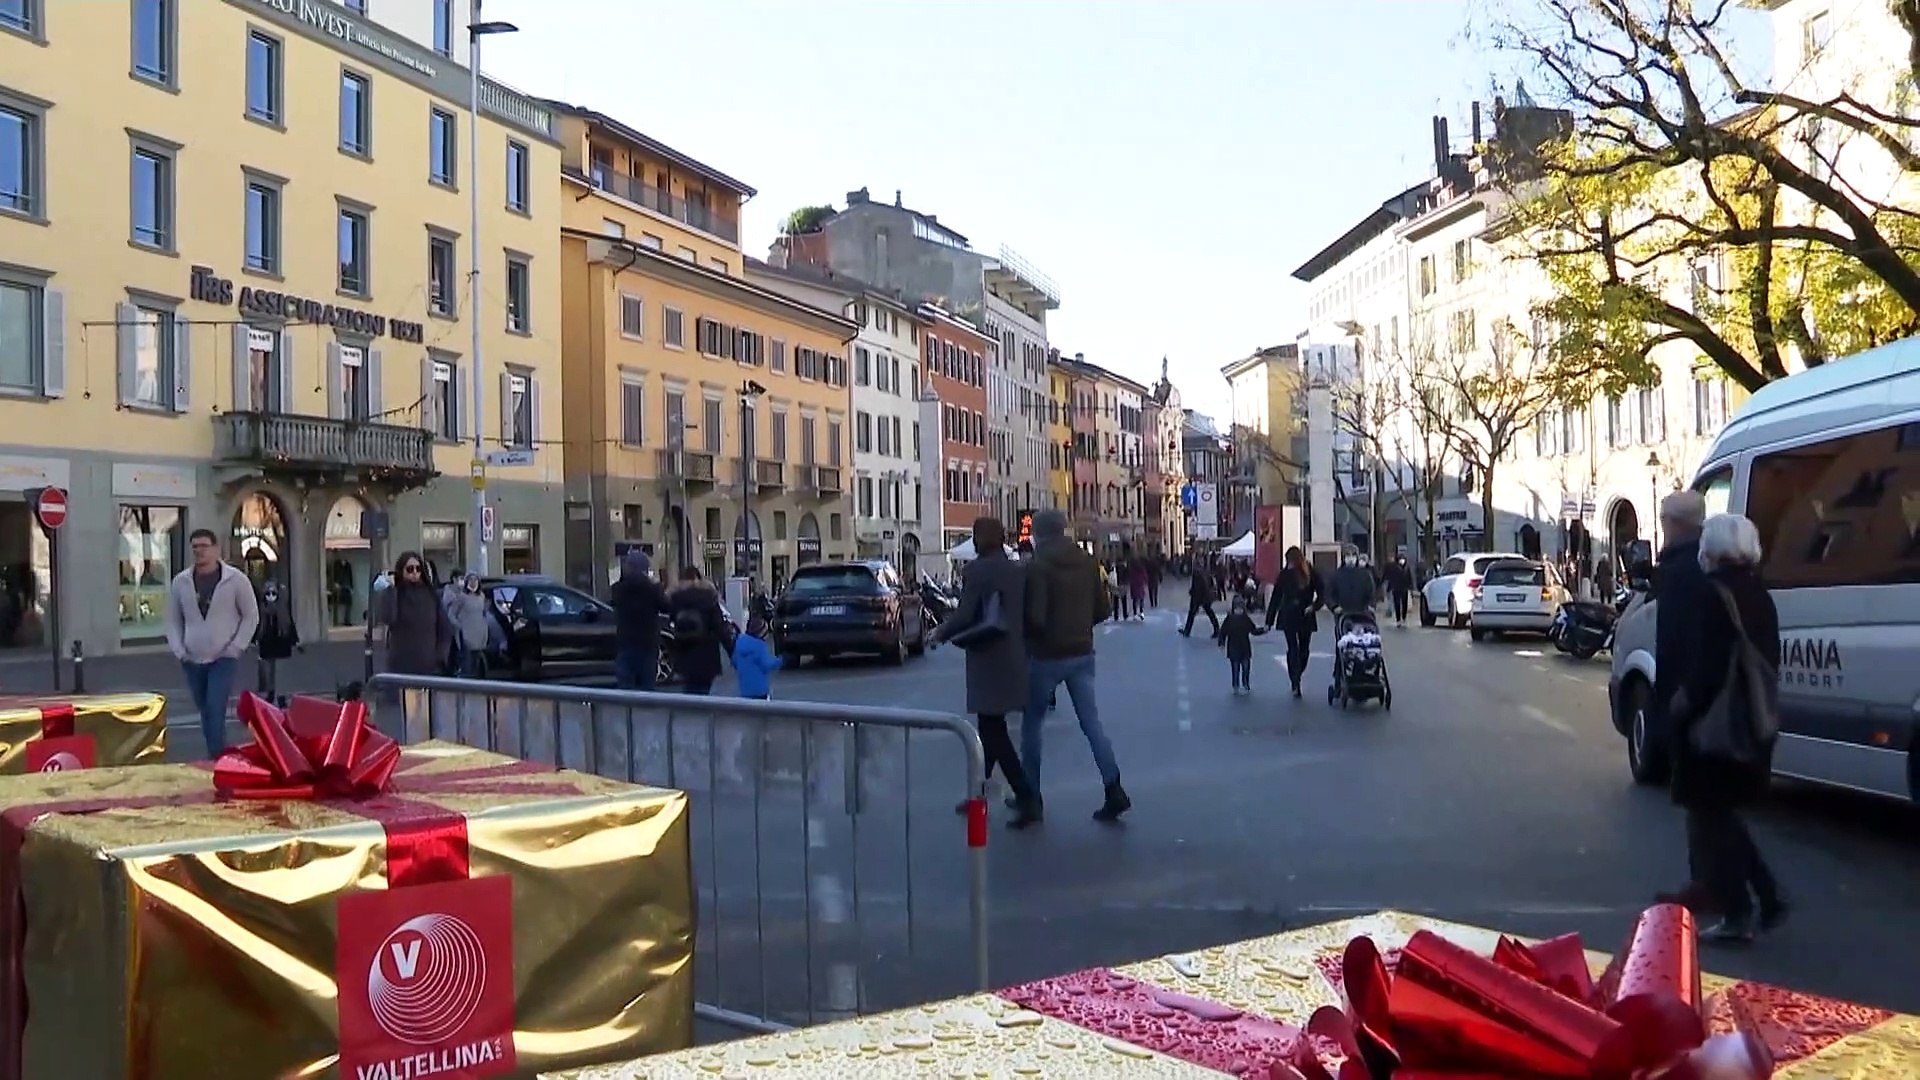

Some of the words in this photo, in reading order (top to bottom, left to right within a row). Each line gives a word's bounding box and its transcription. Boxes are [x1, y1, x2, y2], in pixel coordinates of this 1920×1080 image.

[300, 0, 354, 42] INVEST
[239, 286, 386, 336] ASSICURAZIONI
[1778, 638, 1842, 671] IANA
[357, 1039, 494, 1080] VALTELLINA
